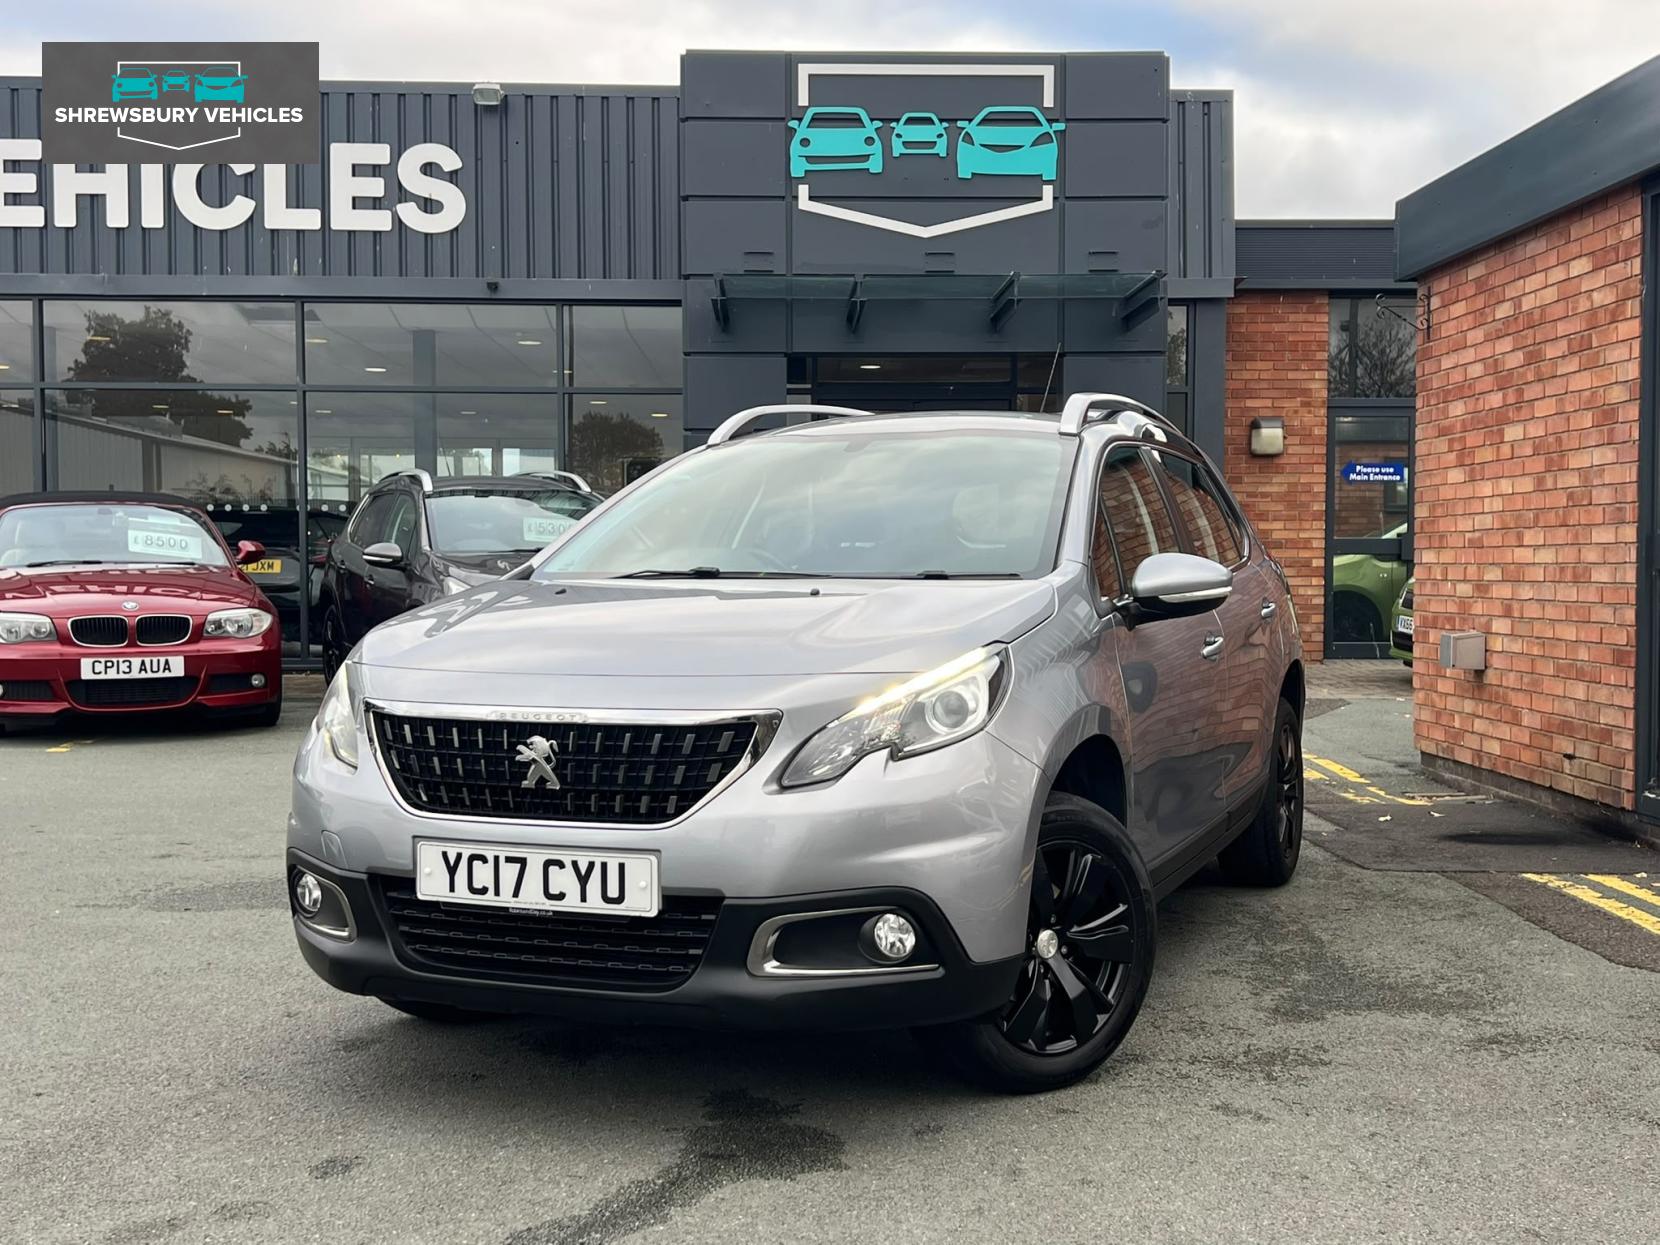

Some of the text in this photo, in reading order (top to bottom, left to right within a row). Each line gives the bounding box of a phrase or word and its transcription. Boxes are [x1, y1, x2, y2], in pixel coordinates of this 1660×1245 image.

[1355, 465, 1380, 473] Please
[1349, 473, 1401, 481] Main Entrance
[252, 560, 274, 571] JXM
[91, 658, 172, 676] CP13 AUA
[500, 712, 577, 721] PEUGEOT
[441, 850, 626, 905] YC17 CYU
